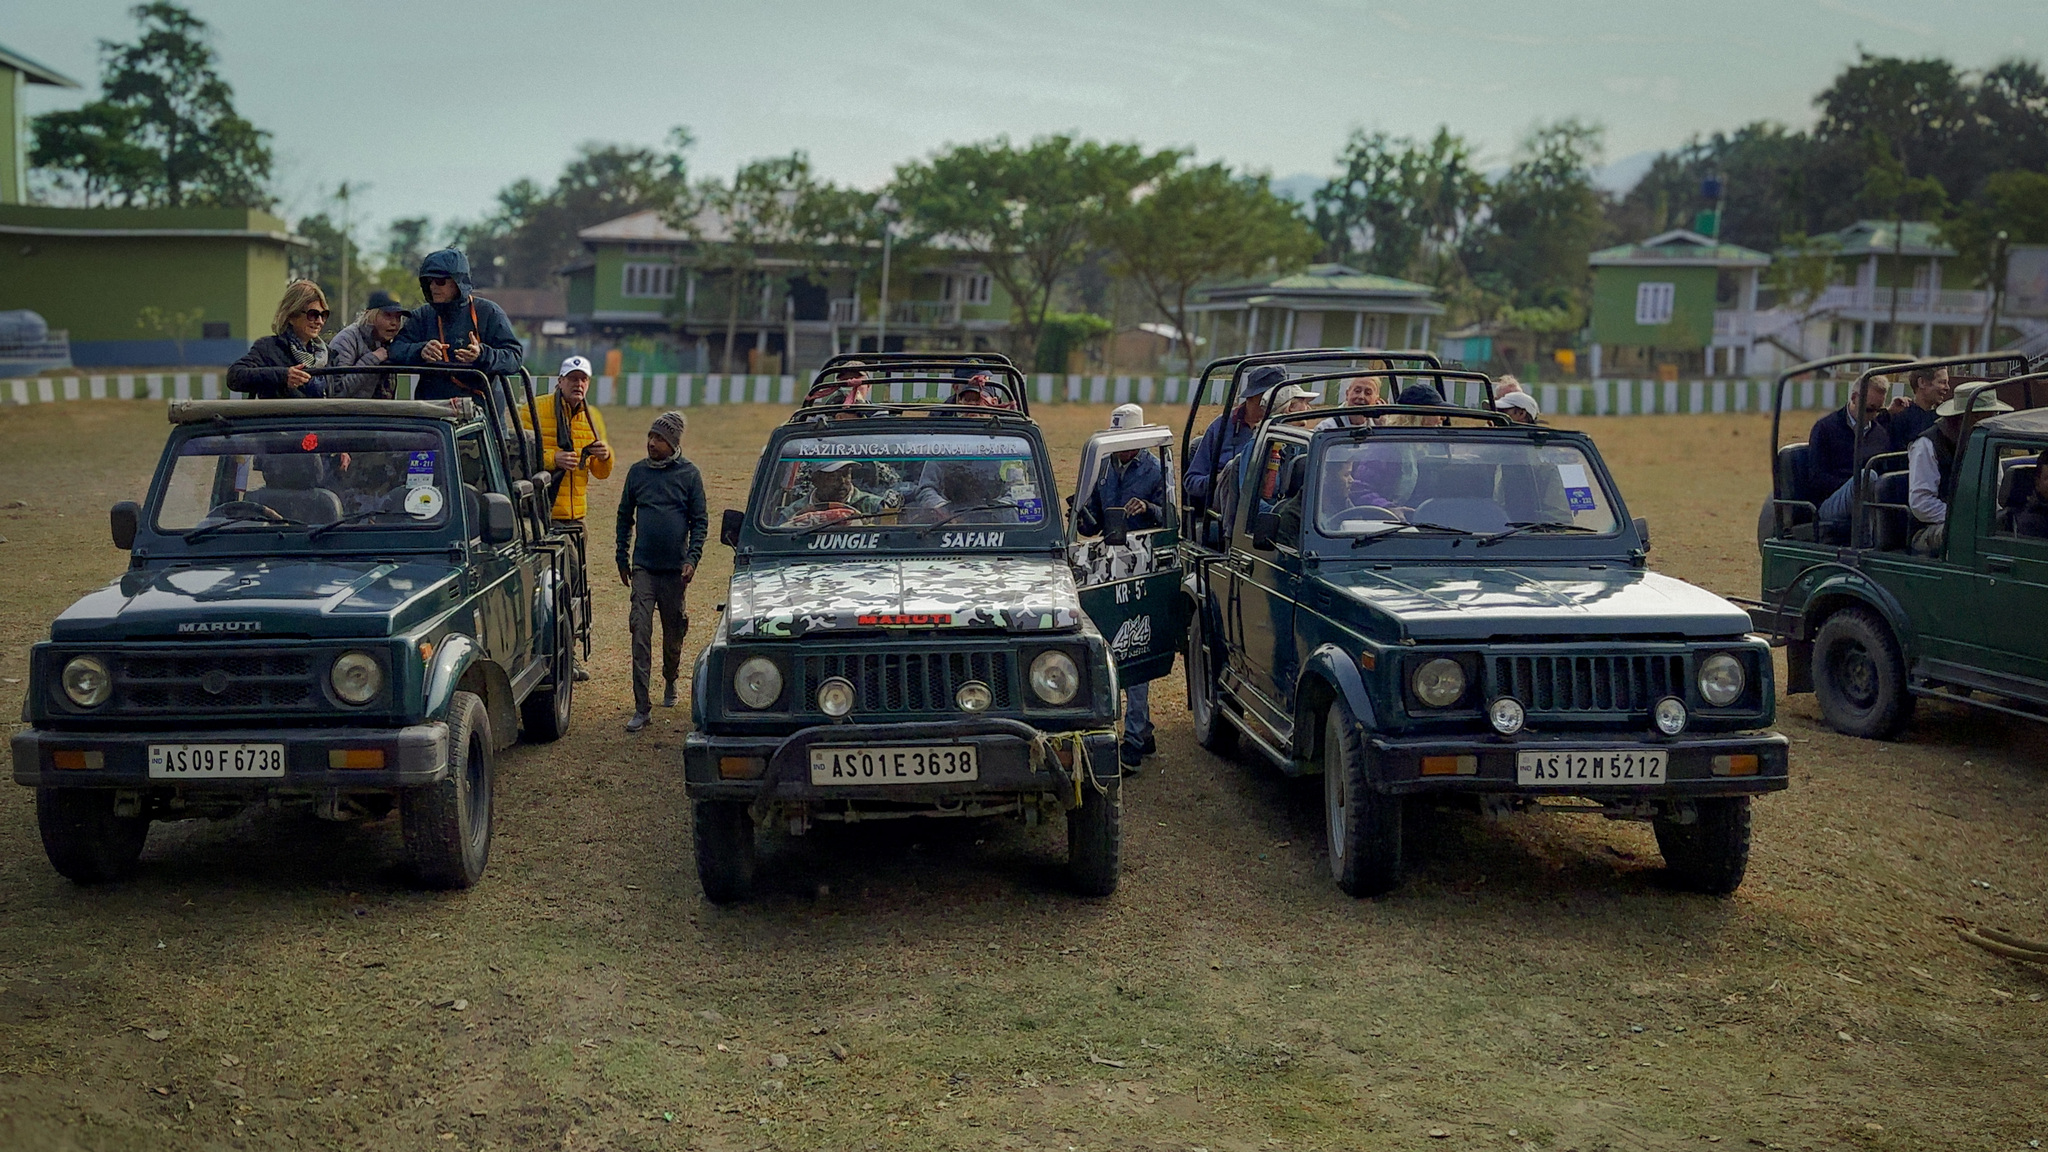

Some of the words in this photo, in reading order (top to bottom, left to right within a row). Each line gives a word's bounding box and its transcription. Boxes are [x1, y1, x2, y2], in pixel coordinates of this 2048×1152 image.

[798, 443, 890, 456] KAZIRANGA
[894, 443, 972, 456] NATIONAL
[977, 442, 1018, 455] PARK
[807, 533, 881, 549] JUNGLE
[940, 532, 1005, 548] SAFARI
[858, 614, 951, 624] MARUTI
[178, 621, 261, 632] MARUTI
